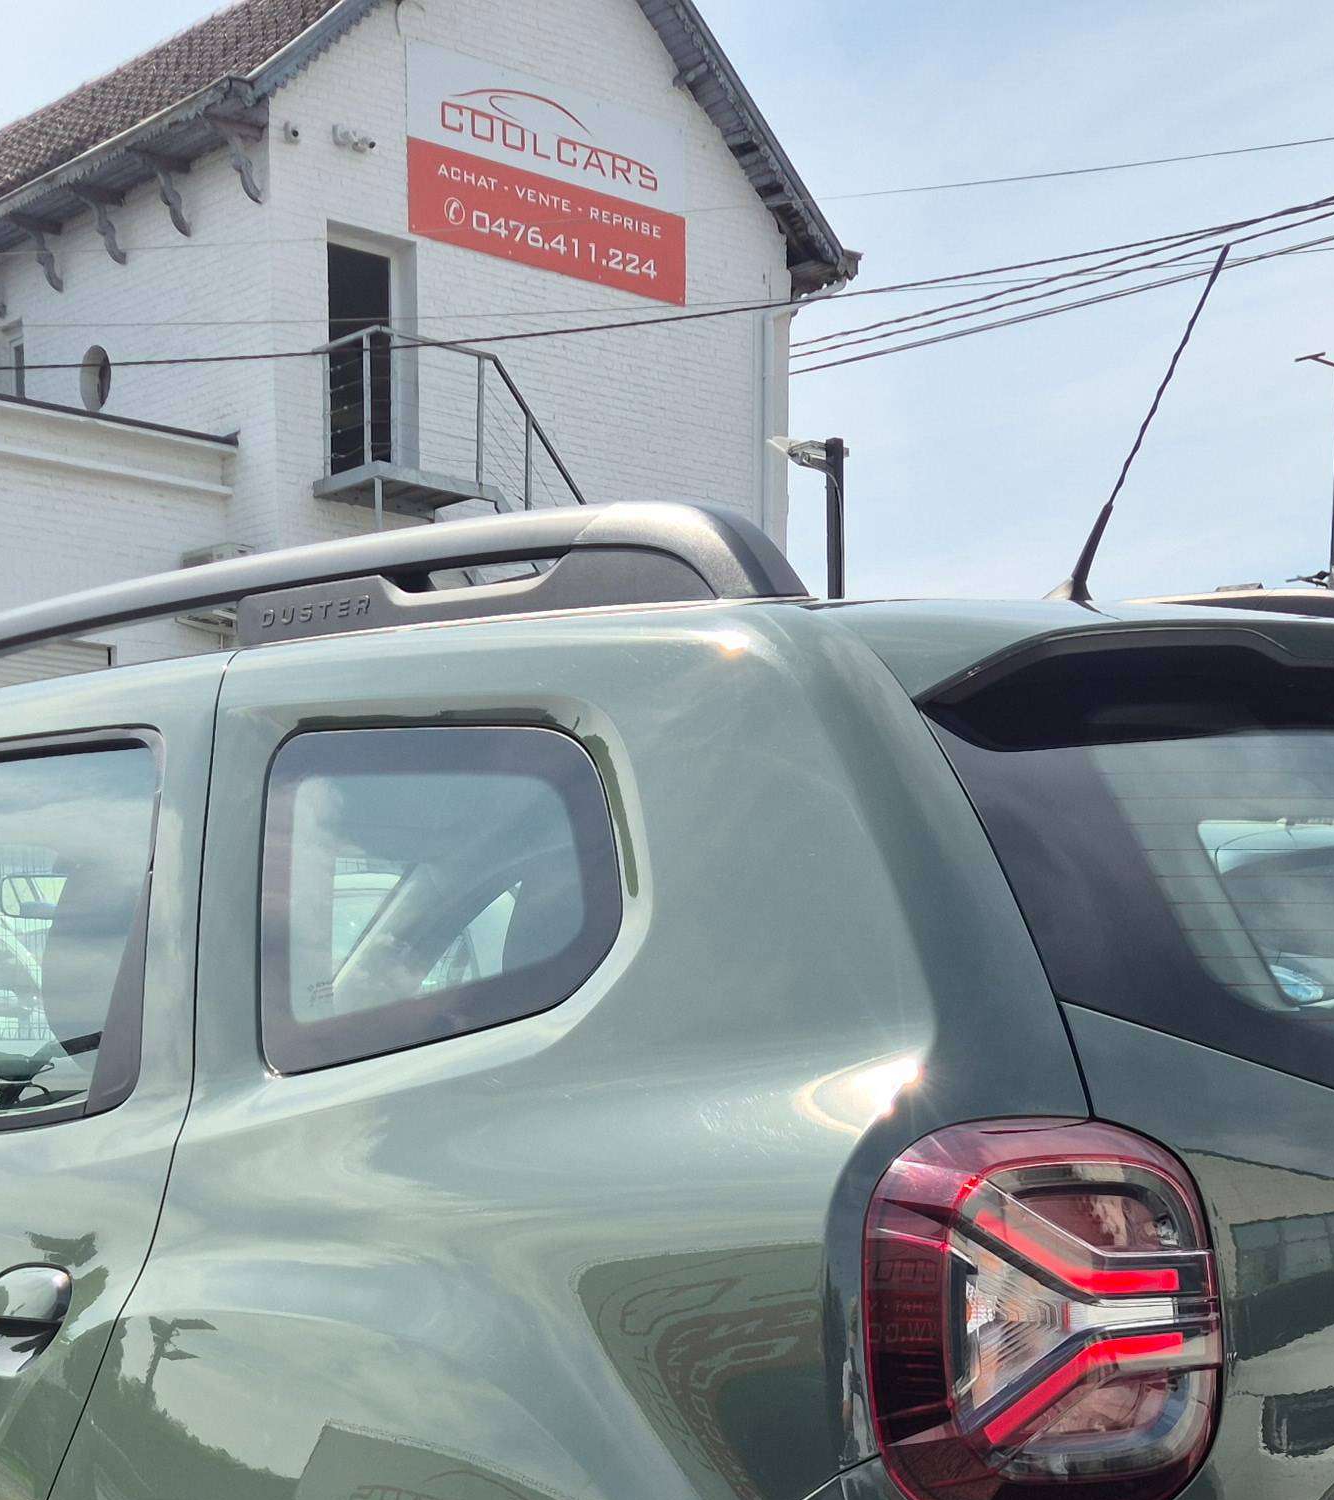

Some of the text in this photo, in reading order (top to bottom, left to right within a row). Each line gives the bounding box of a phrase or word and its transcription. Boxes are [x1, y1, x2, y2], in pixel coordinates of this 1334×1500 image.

[438, 163, 498, 191] ACHAT
[515, 185, 572, 212] VENTE
[590, 207, 662, 239] REPRISE
[472, 211, 657, 279] 0476.411.224
[261, 594, 371, 628] DUSTER
